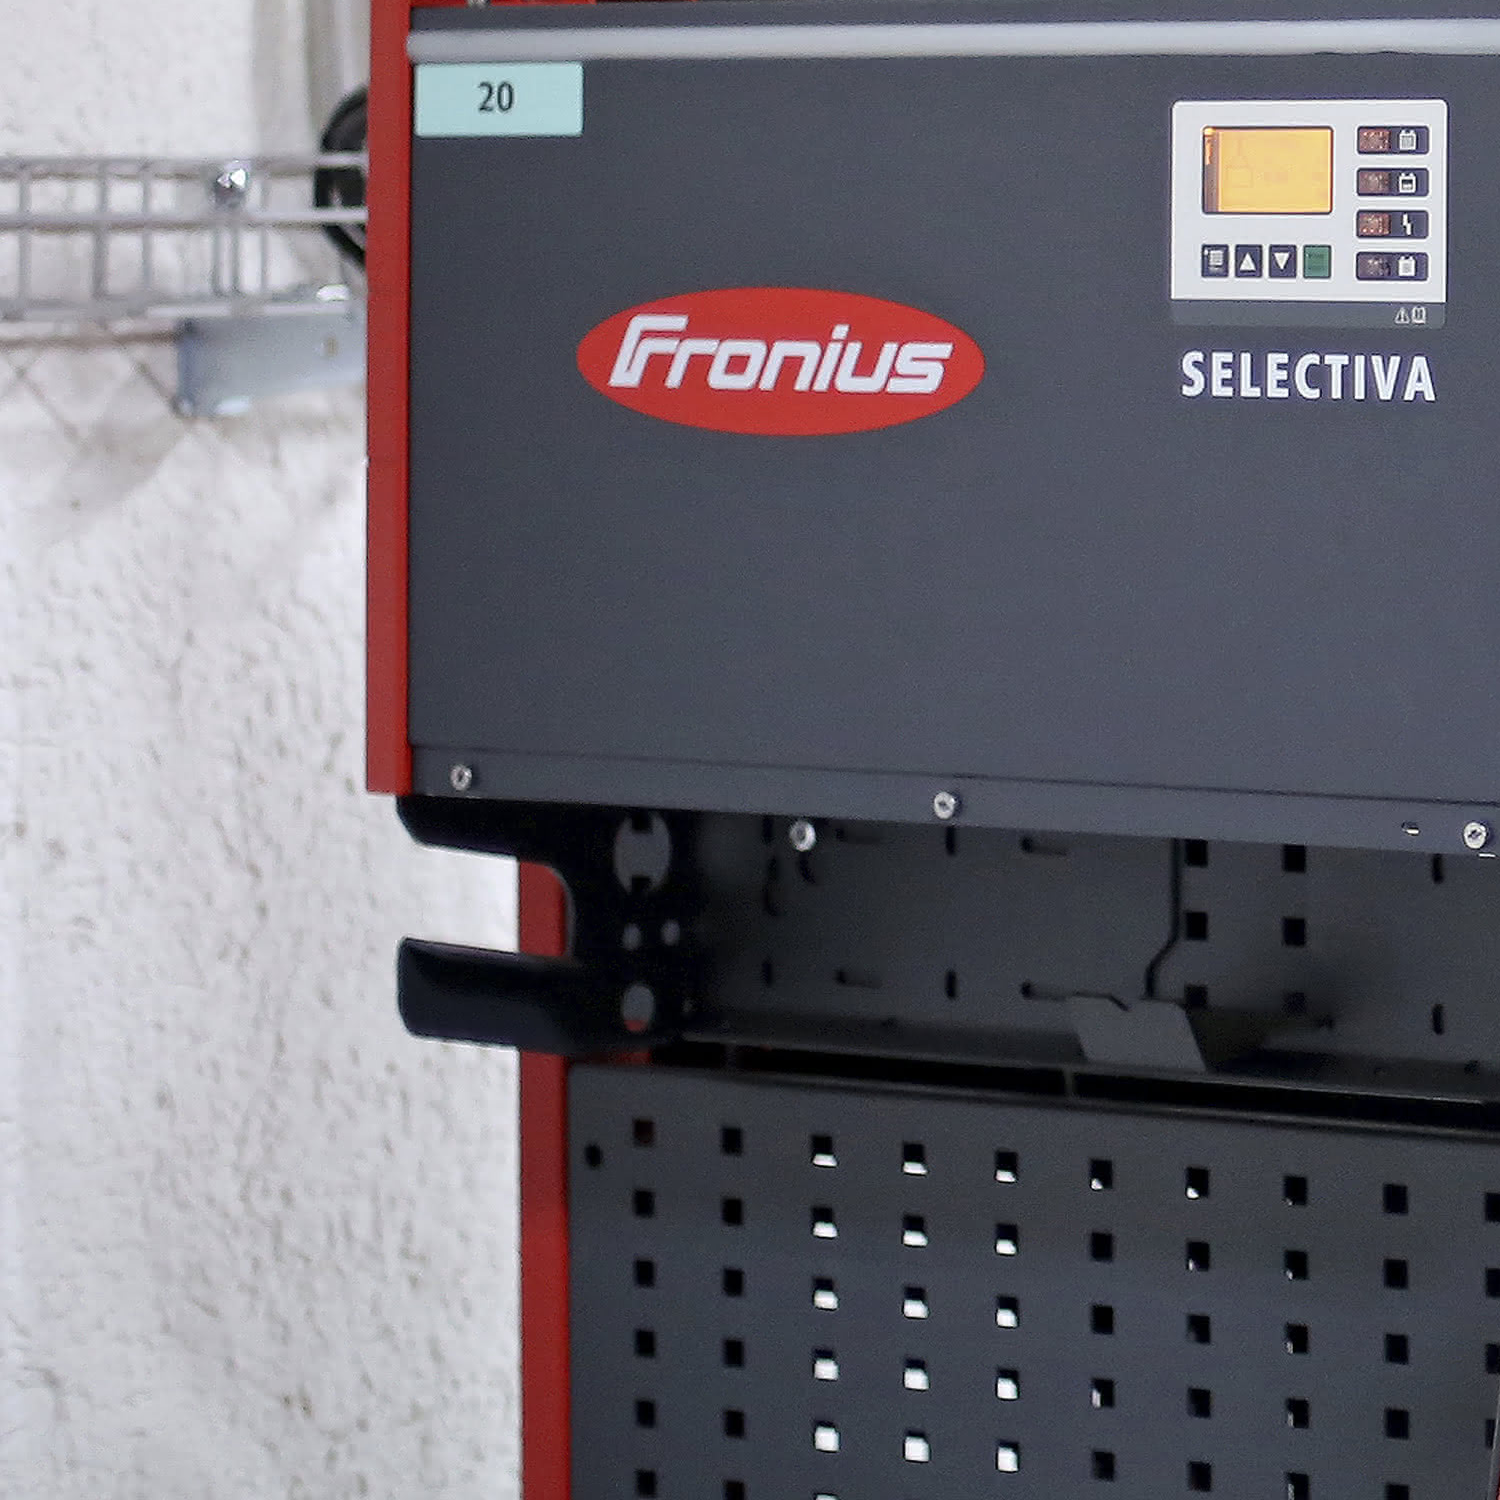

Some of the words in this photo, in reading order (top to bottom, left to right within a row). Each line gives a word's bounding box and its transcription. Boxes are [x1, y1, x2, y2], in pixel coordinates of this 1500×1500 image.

[477, 81, 515, 114] 20
[608, 313, 954, 394] Fronius
[1180, 350, 1437, 402] SELECTIVA
